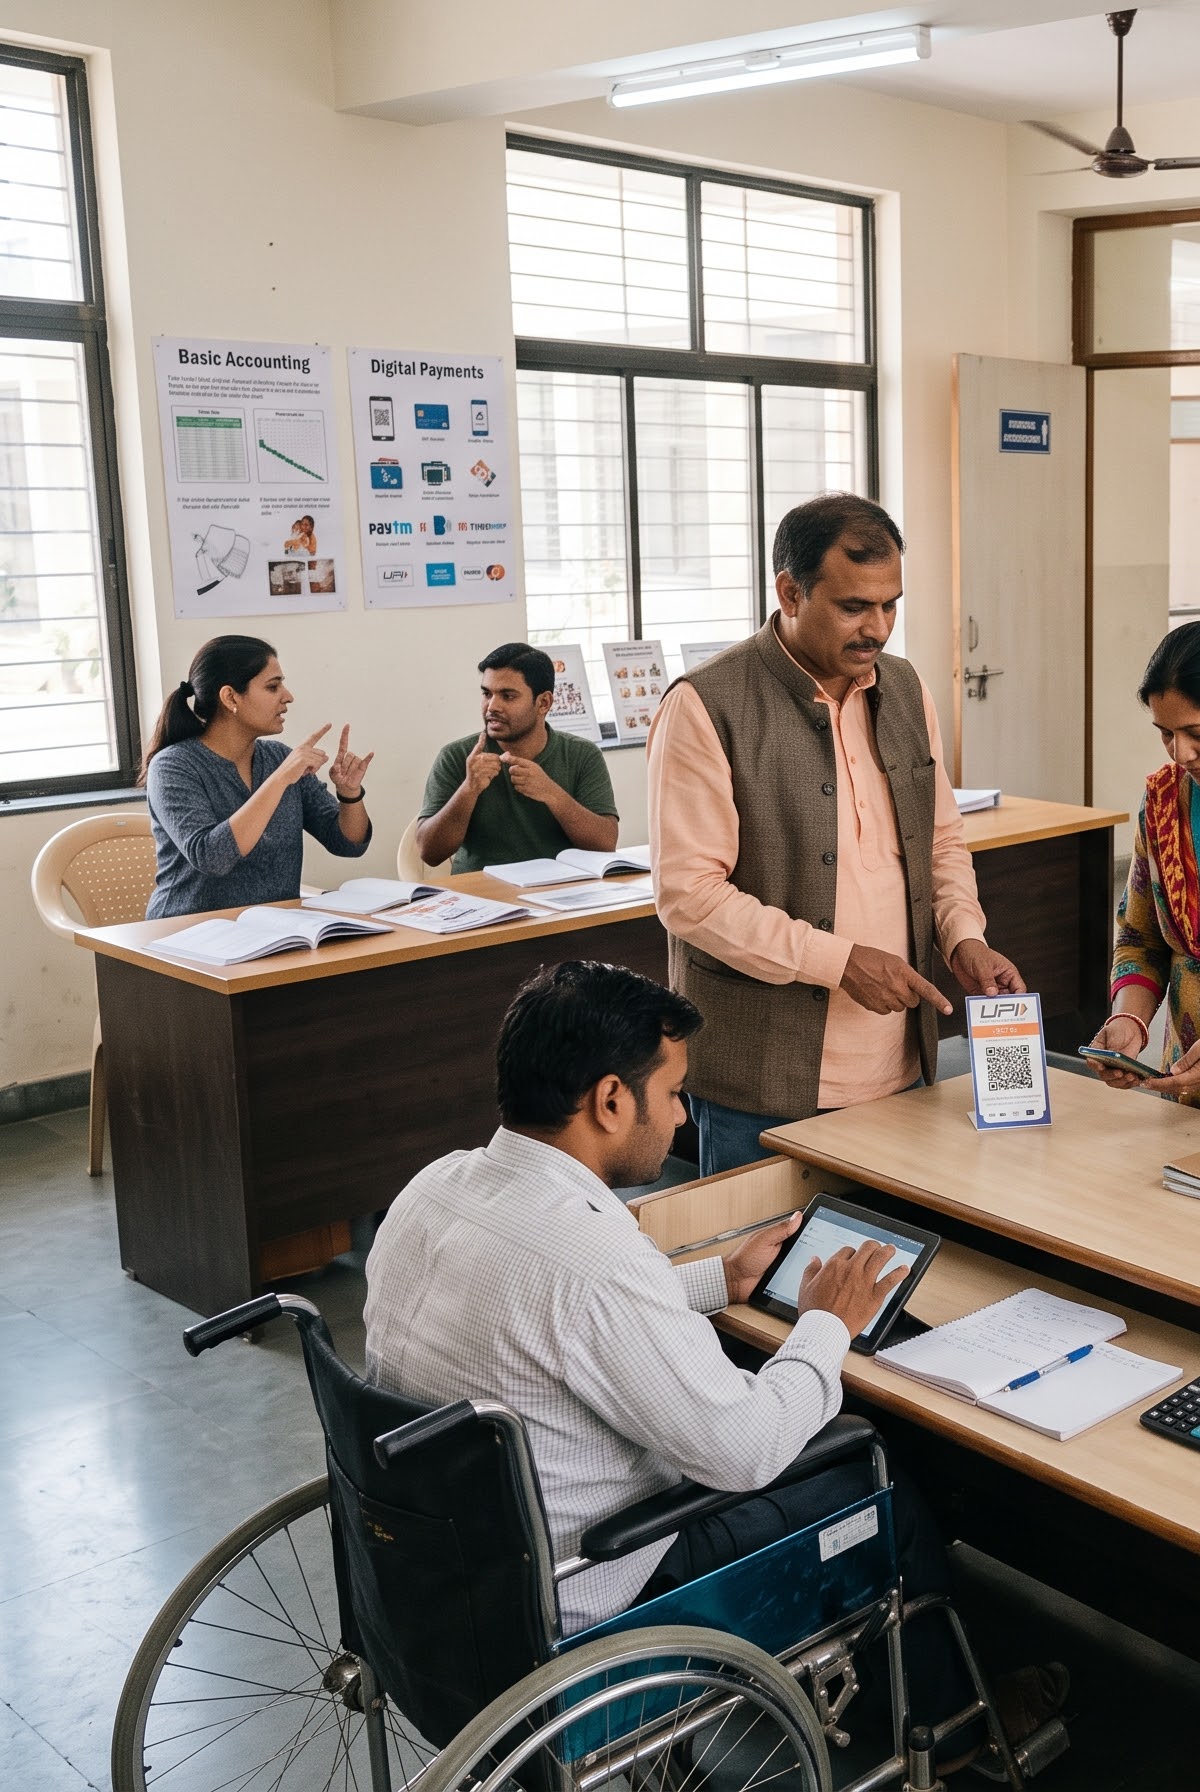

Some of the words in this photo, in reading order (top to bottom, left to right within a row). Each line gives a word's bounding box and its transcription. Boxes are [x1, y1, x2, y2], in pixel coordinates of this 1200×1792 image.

[178, 349, 222, 366] Basic
[226, 352, 311, 374] Accounting
[371, 359, 416, 378] Digital
[420, 362, 484, 380] Payments
[980, 1002, 1019, 1019] UPI
